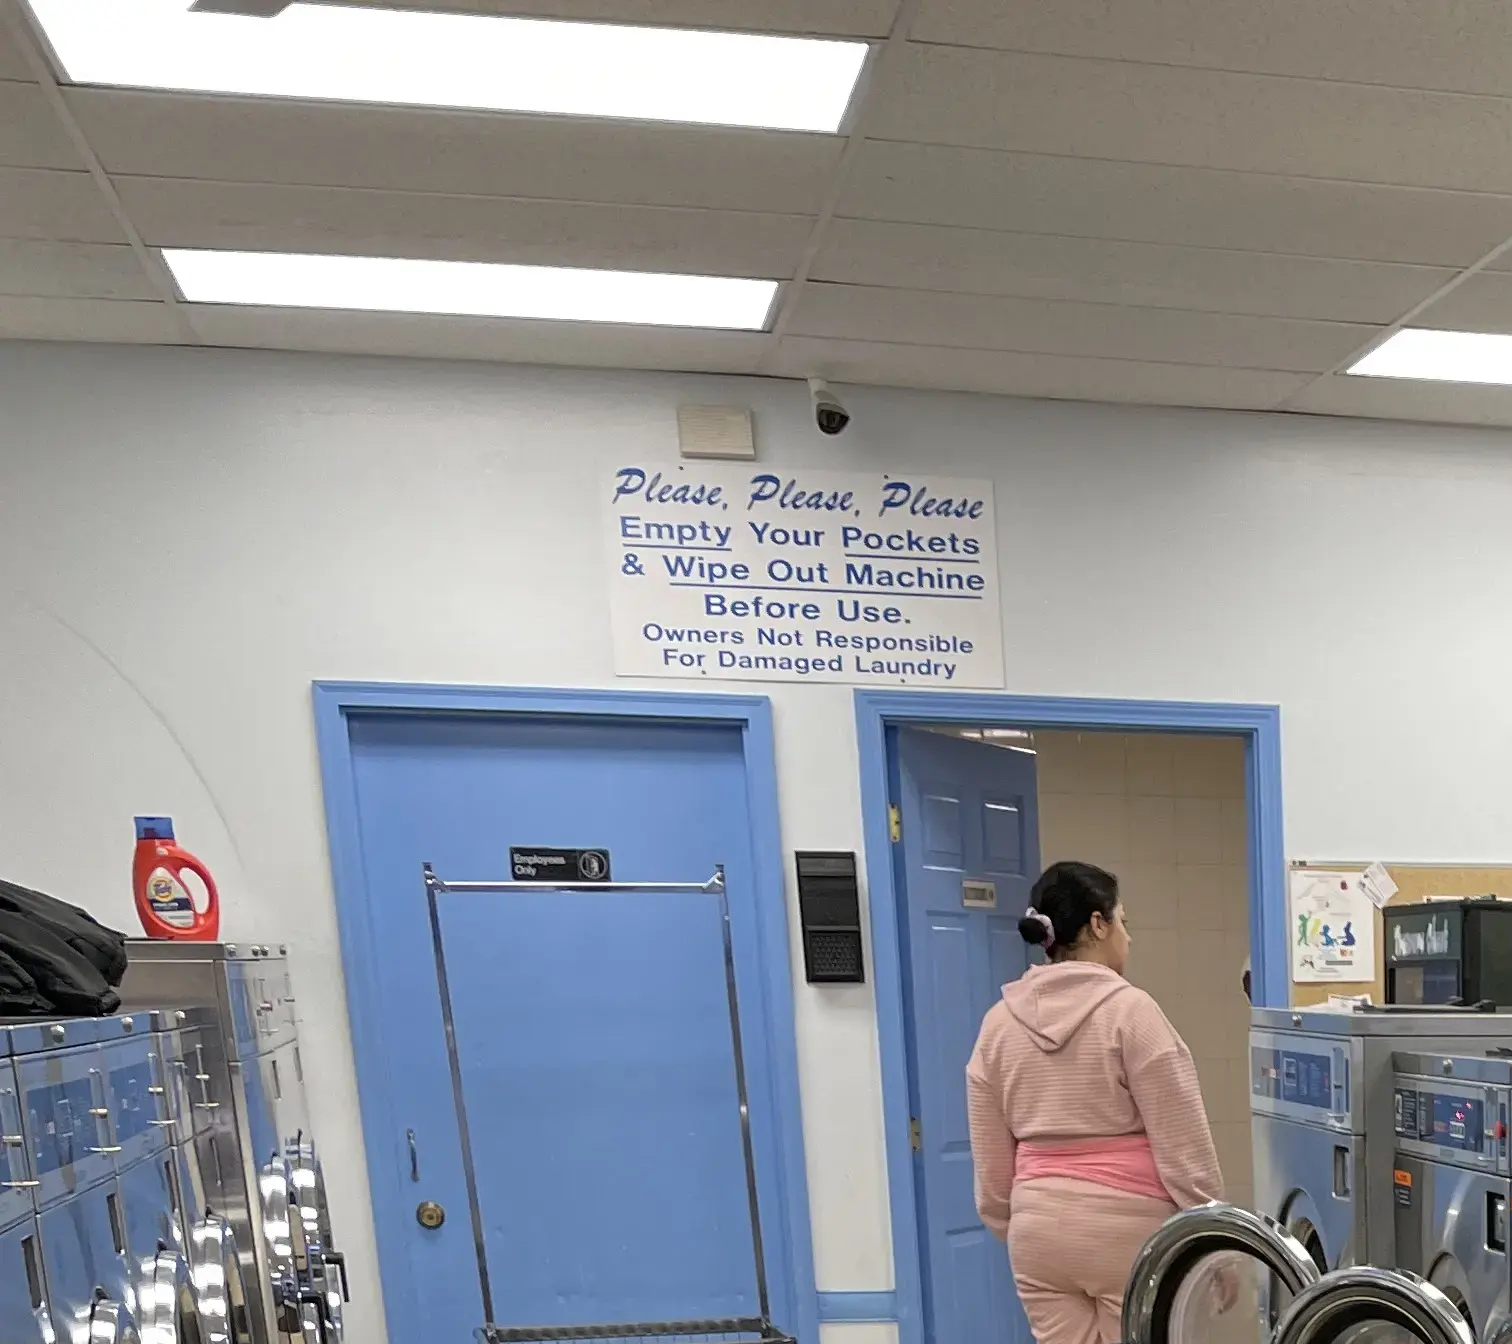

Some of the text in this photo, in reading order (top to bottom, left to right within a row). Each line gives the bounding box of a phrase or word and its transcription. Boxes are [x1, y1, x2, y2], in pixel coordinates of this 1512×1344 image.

[612, 467, 984, 520] Please, Please, Please
[620, 516, 980, 555] Empty Your Pockets
[621, 553, 985, 591] & Wipe Out Machine
[704, 594, 911, 625] Before Use.
[643, 623, 973, 655] Owners Not Responsible
[663, 649, 956, 679] For Damaged Laundry
